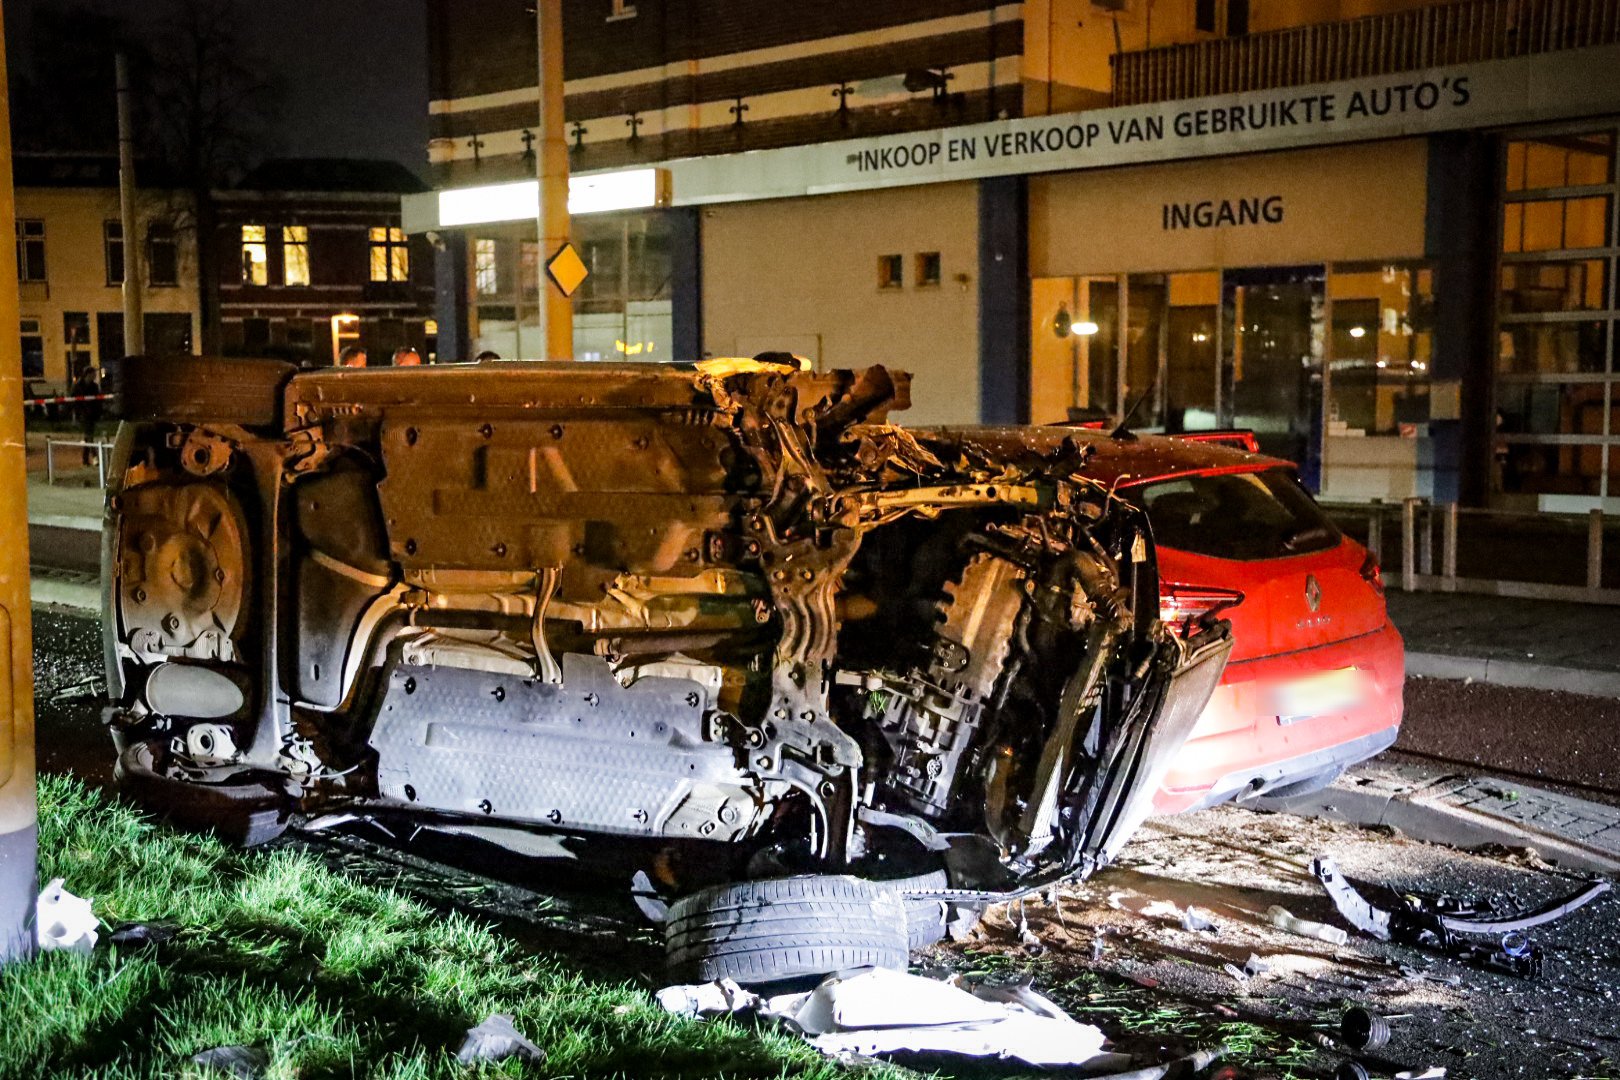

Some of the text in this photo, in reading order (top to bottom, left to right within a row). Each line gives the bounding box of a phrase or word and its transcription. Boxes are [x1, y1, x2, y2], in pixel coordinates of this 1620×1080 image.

[857, 76, 1471, 172] INKOOP EN VERKOOP VAN GEBRUIKTE AUTO'S
[1162, 195, 1284, 231] INGANG
